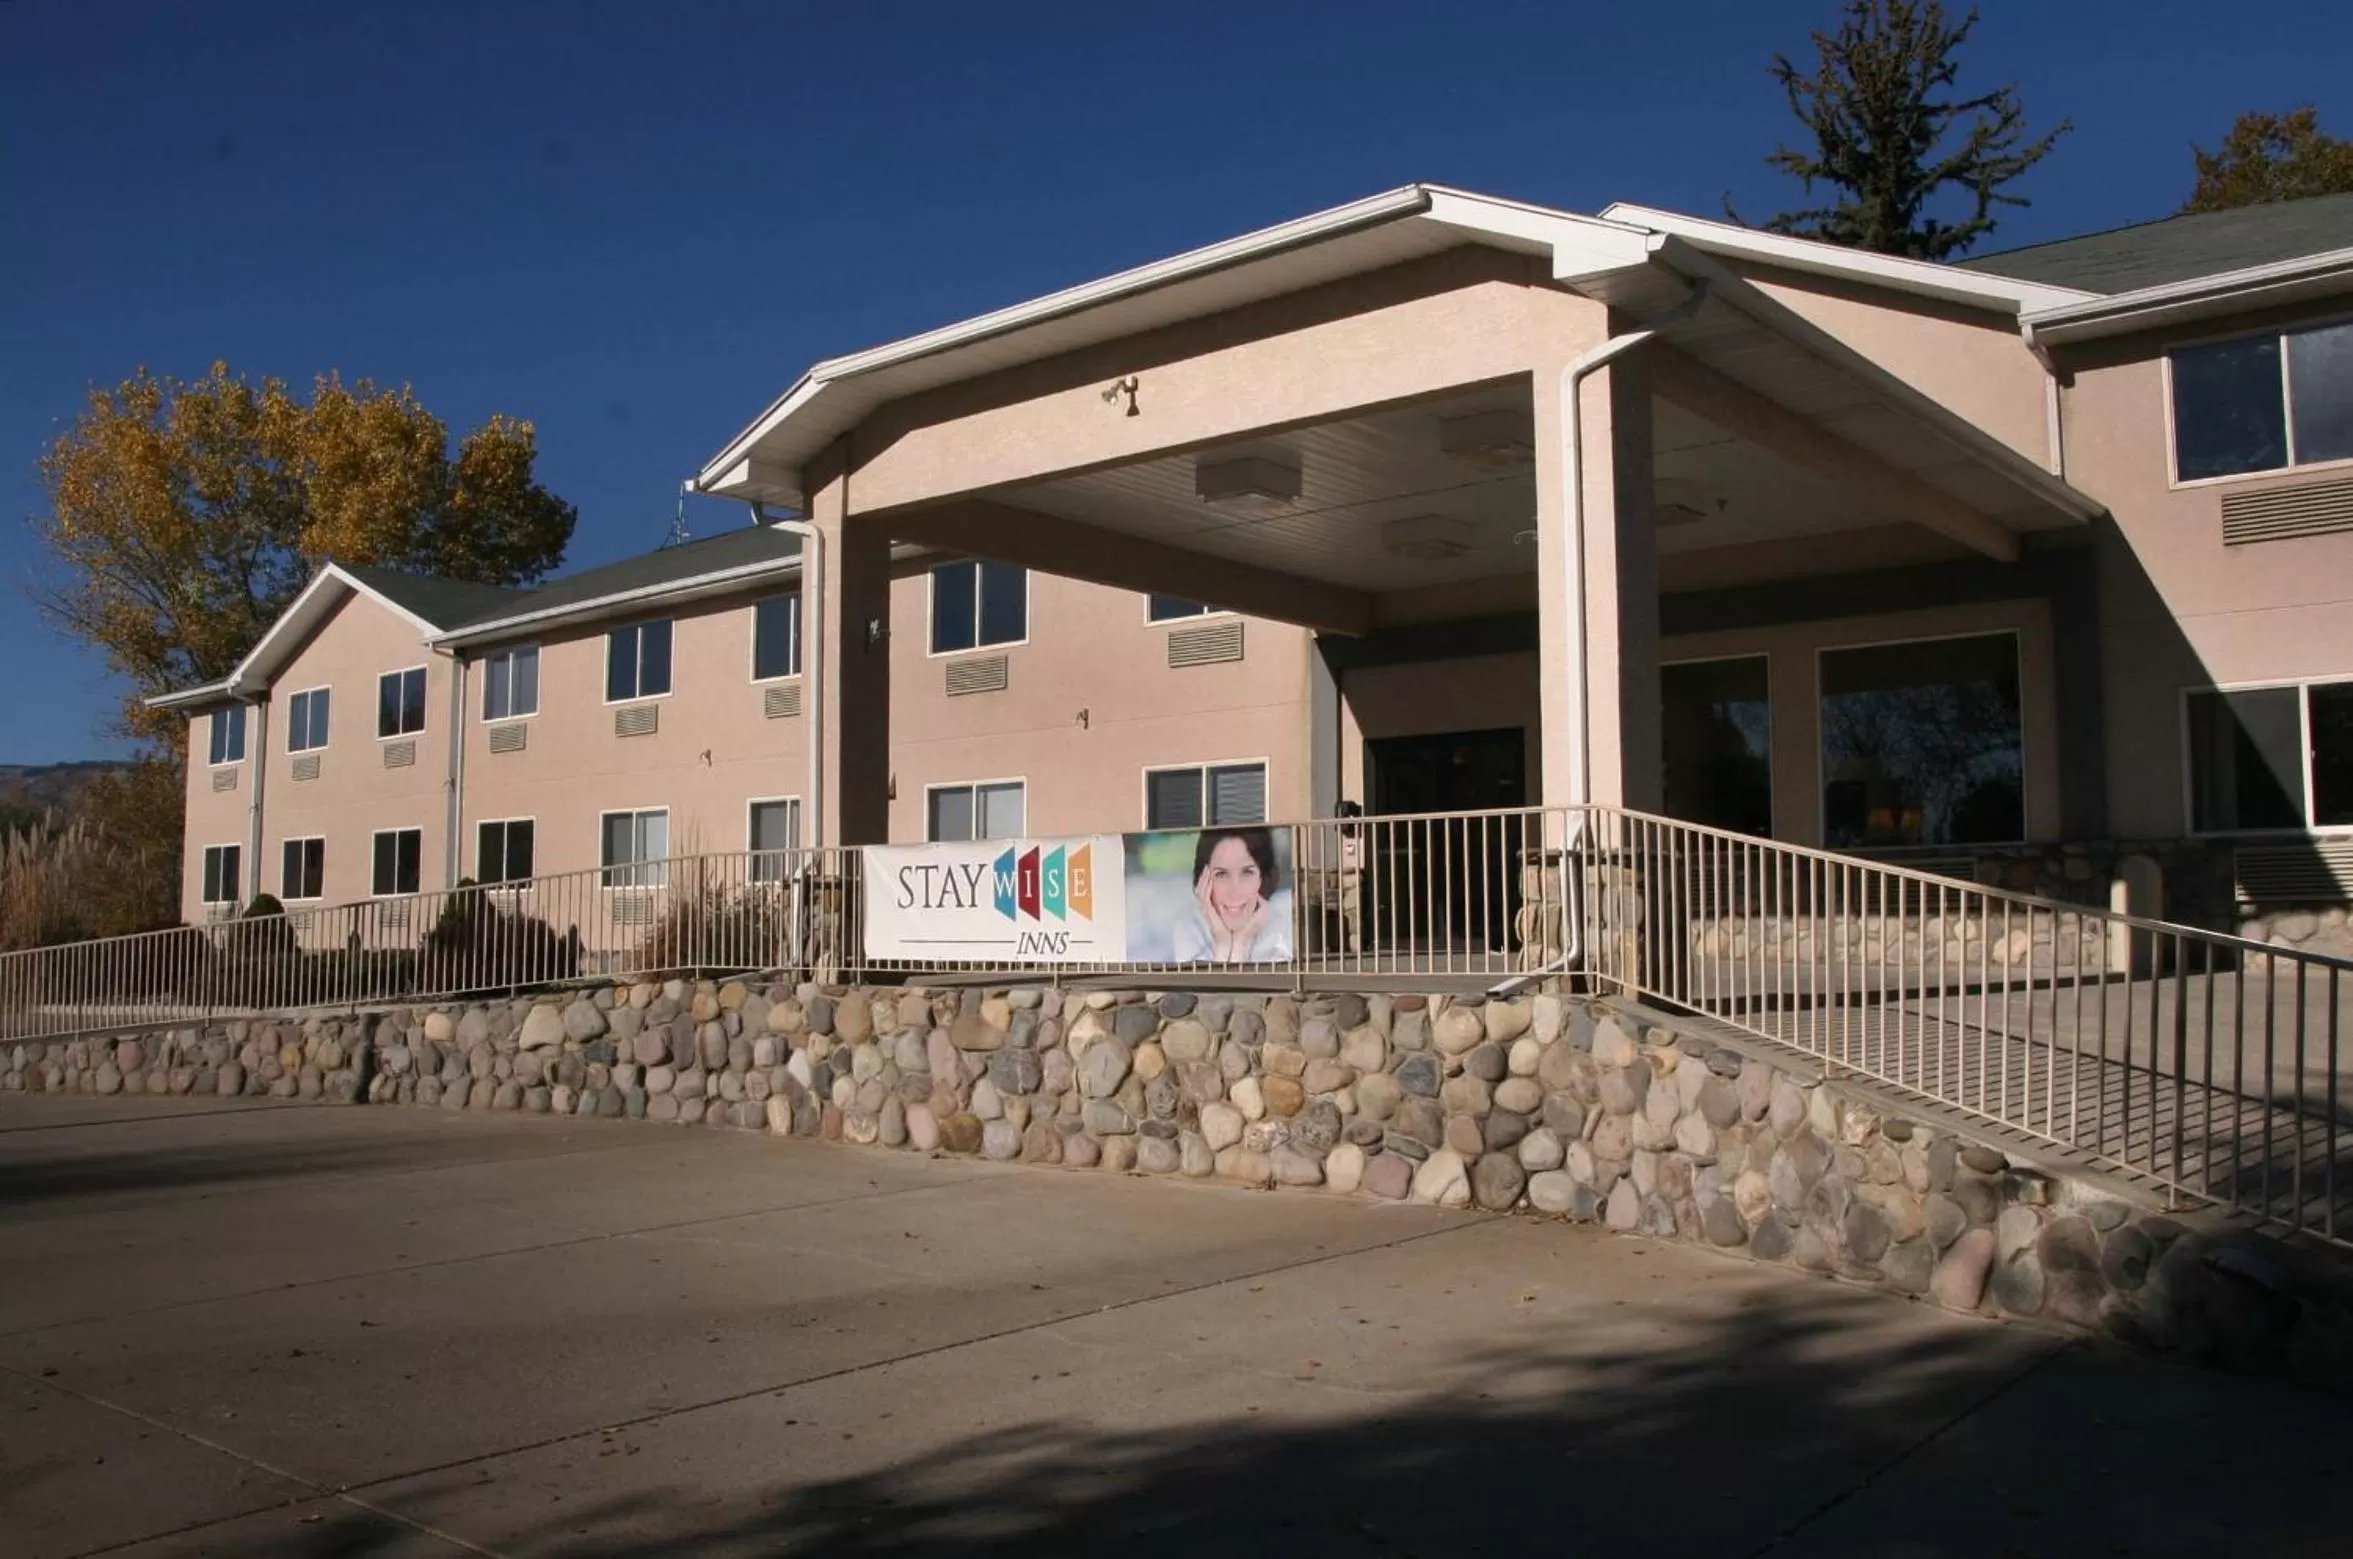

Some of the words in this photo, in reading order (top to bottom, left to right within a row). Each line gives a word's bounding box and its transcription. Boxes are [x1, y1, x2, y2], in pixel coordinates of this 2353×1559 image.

[898, 864, 988, 909] STAY
[993, 868, 1088, 898] WISE
[1017, 931, 1070, 955] INNS
